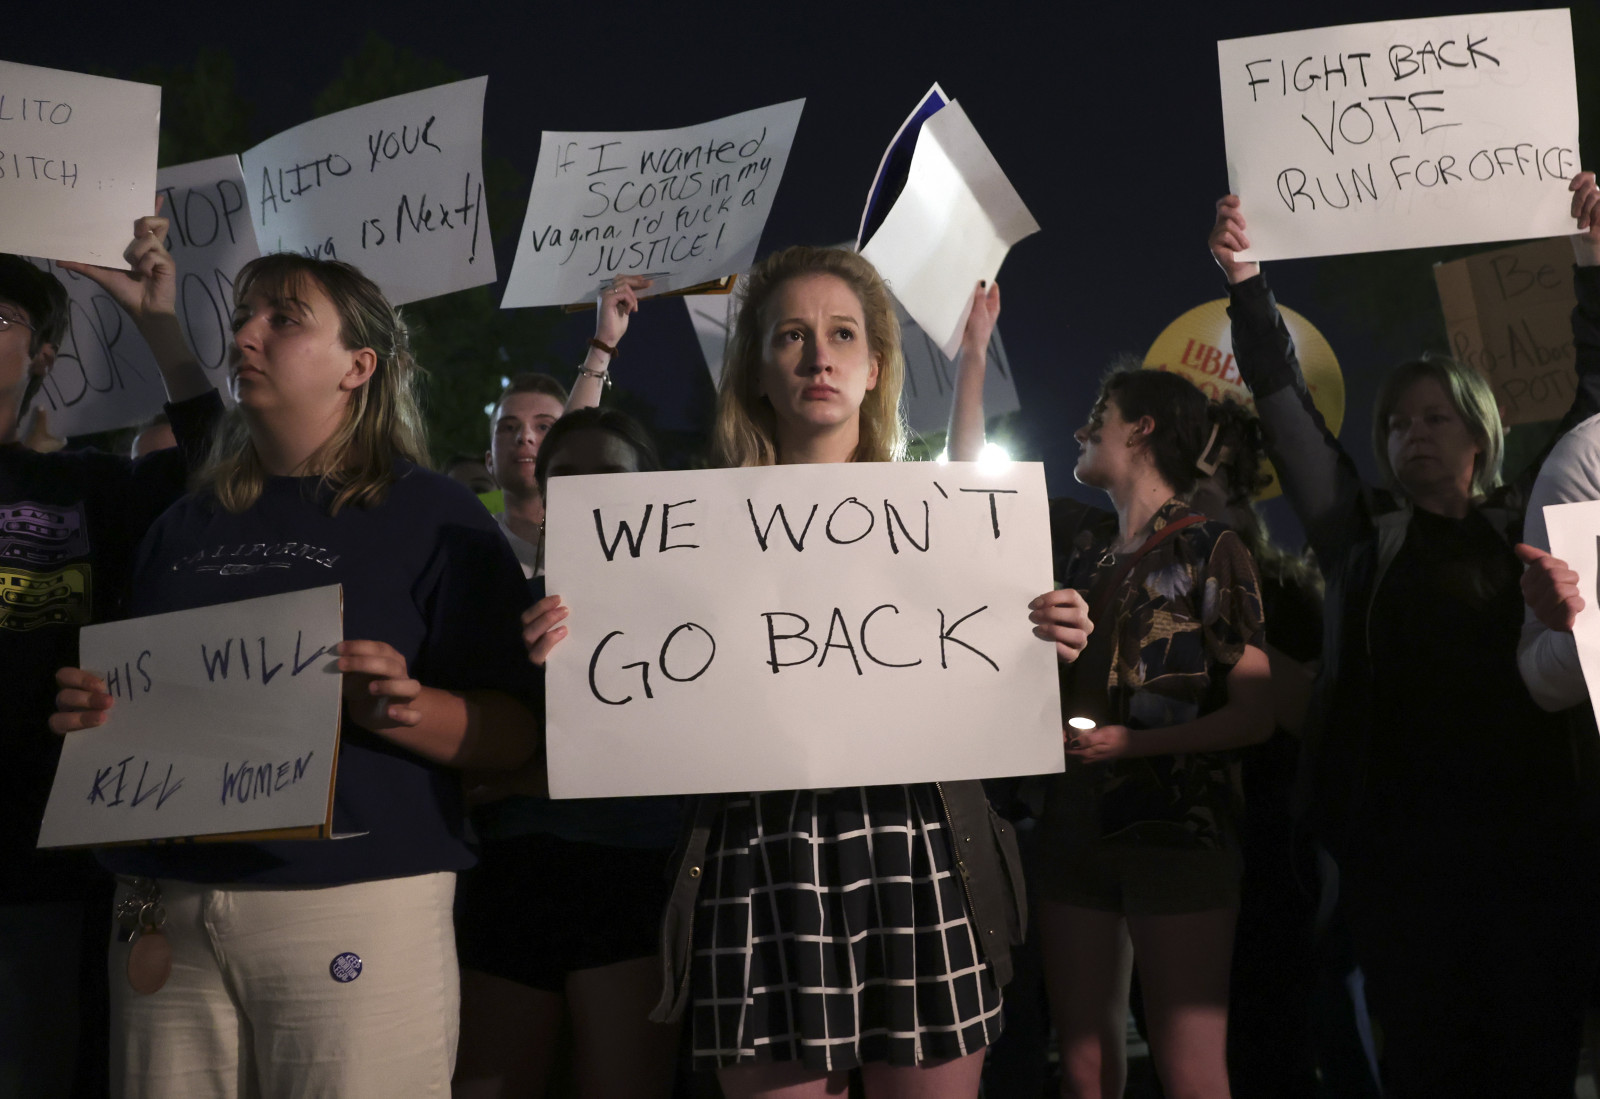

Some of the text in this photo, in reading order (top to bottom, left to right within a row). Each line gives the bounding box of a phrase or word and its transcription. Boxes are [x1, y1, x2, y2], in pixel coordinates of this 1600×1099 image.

[1245, 34, 1500, 102] FIGHT BACK
[587, 141, 628, 176] I
[640, 127, 767, 175] wanted
[1301, 90, 1463, 155] VOTE
[260, 154, 352, 226] ALITO
[582, 156, 773, 218] SCOTUS in my
[1277, 144, 1575, 212] RUN FOR OFFICE
[157, 180, 243, 252] TOP
[631, 210, 664, 238] I'd
[741, 188, 756, 208] a
[587, 222, 727, 276] JUSTICE!
[1489, 253, 1562, 301] Be
[593, 481, 1018, 561] WE WON'T
[103, 630, 327, 701] HIS WILL
[588, 604, 1001, 705] GO BACK
[87, 751, 313, 811] KILL WOMEN
